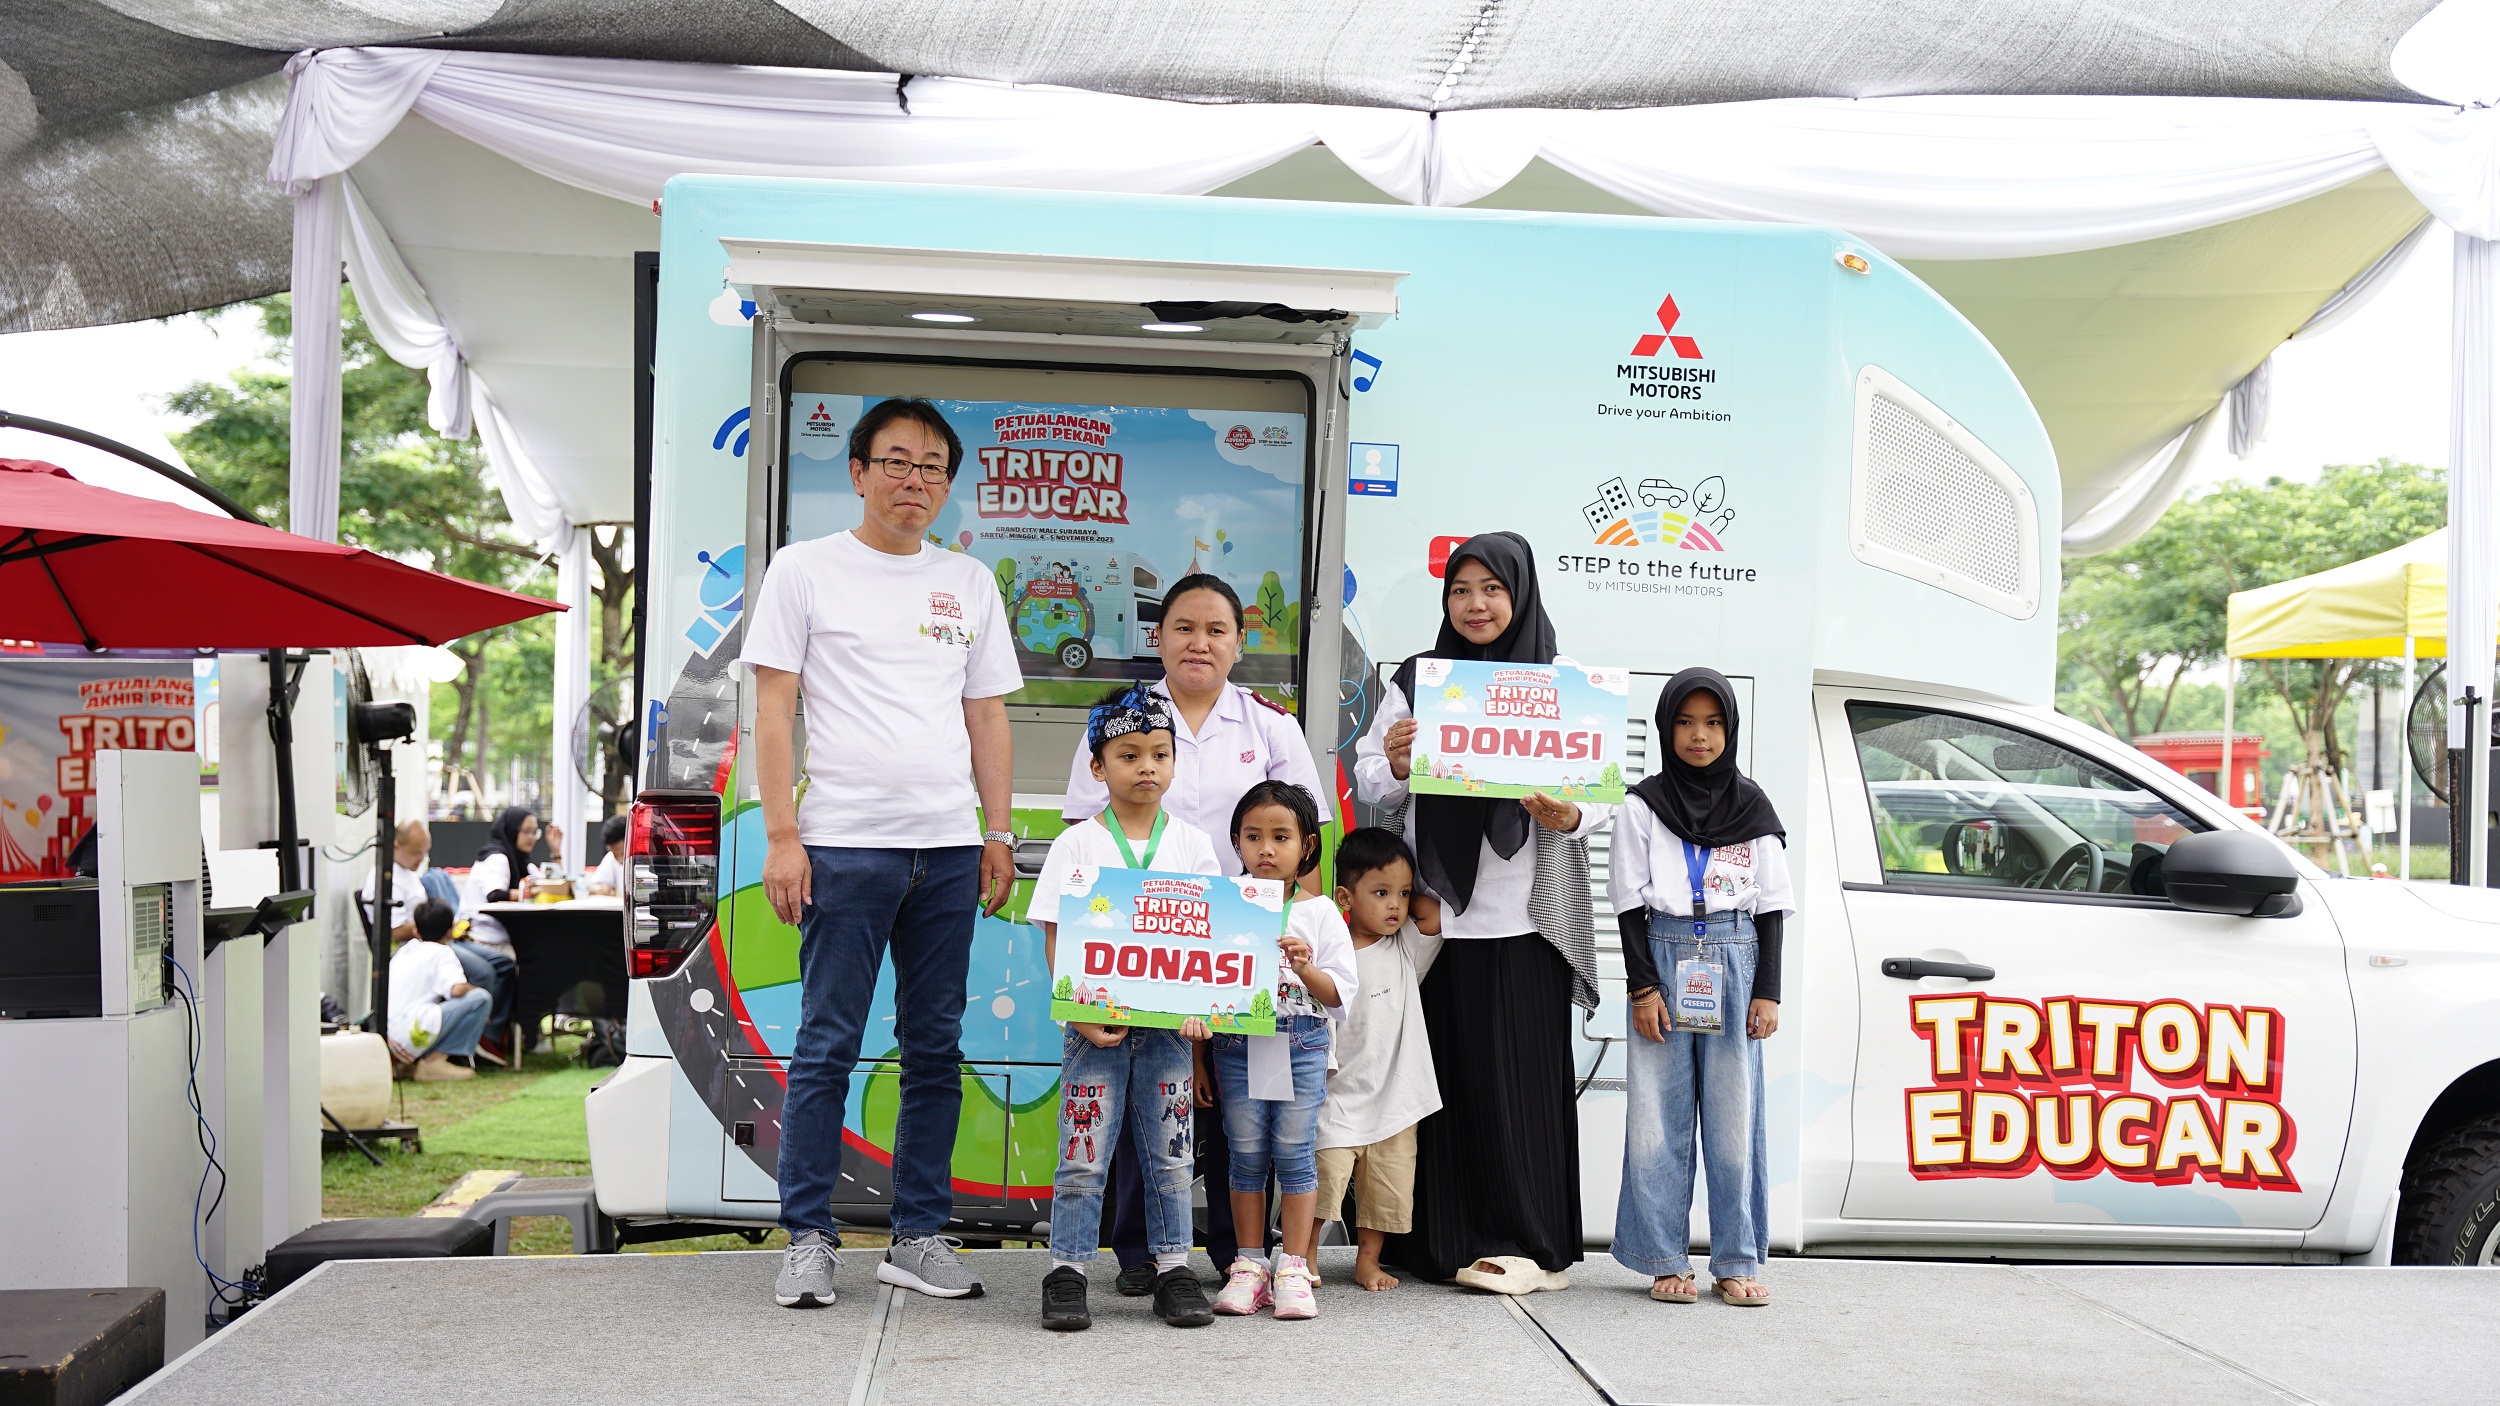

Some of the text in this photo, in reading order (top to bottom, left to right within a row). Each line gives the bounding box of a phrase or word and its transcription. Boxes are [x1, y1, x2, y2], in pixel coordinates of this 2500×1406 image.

[1616, 364, 1716, 384] MITSUBISHI
[1629, 382, 1702, 401] MOTORS
[1597, 403, 1731, 422] Drive your Ambition
[994, 413, 1111, 435] PETUALANGAN
[998, 427, 1105, 447] AKHIR PEKAN
[980, 449, 1119, 486] TRITON
[978, 484, 1126, 521] EDUCAR
[1059, 528, 1098, 536] SURABAYA
[1557, 555, 1757, 582] STEP to the future
[1057, 577, 1073, 585] KIDS
[1587, 579, 1724, 597] by MITSUBISHI MOTORS
[929, 599, 960, 610] TRITON
[930, 607, 962, 619] EDUCAR
[1494, 669, 1552, 680] PETUALANGAN
[1522, 676, 1549, 685] PEKAN
[79, 677, 193, 697] PETUALANG
[1486, 685, 1557, 703] TRITON
[85, 692, 194, 709] AKHIR PEKA
[1485, 700, 1559, 719] EDUCAR
[60, 716, 194, 750] TRITO
[1438, 723, 1603, 761] DONASI
[1713, 851, 1751, 867] EDUCAR
[1142, 879, 1204, 893] PETUALANGAN
[1145, 886, 1201, 898] AKHIR PEKAN
[1135, 896, 1208, 919] TRITON
[1133, 914, 1209, 937] EDUCAR
[1083, 941, 1254, 987] DONASI
[1686, 986, 1713, 994] EDUCAR
[1687, 979, 1712, 988] TRITON
[1683, 999, 1714, 1008] PESERTA
[1911, 994, 2276, 1094] TRITON
[1065, 1083, 1106, 1098] TOBOT
[1907, 1088, 2290, 1184] EDUCAR
